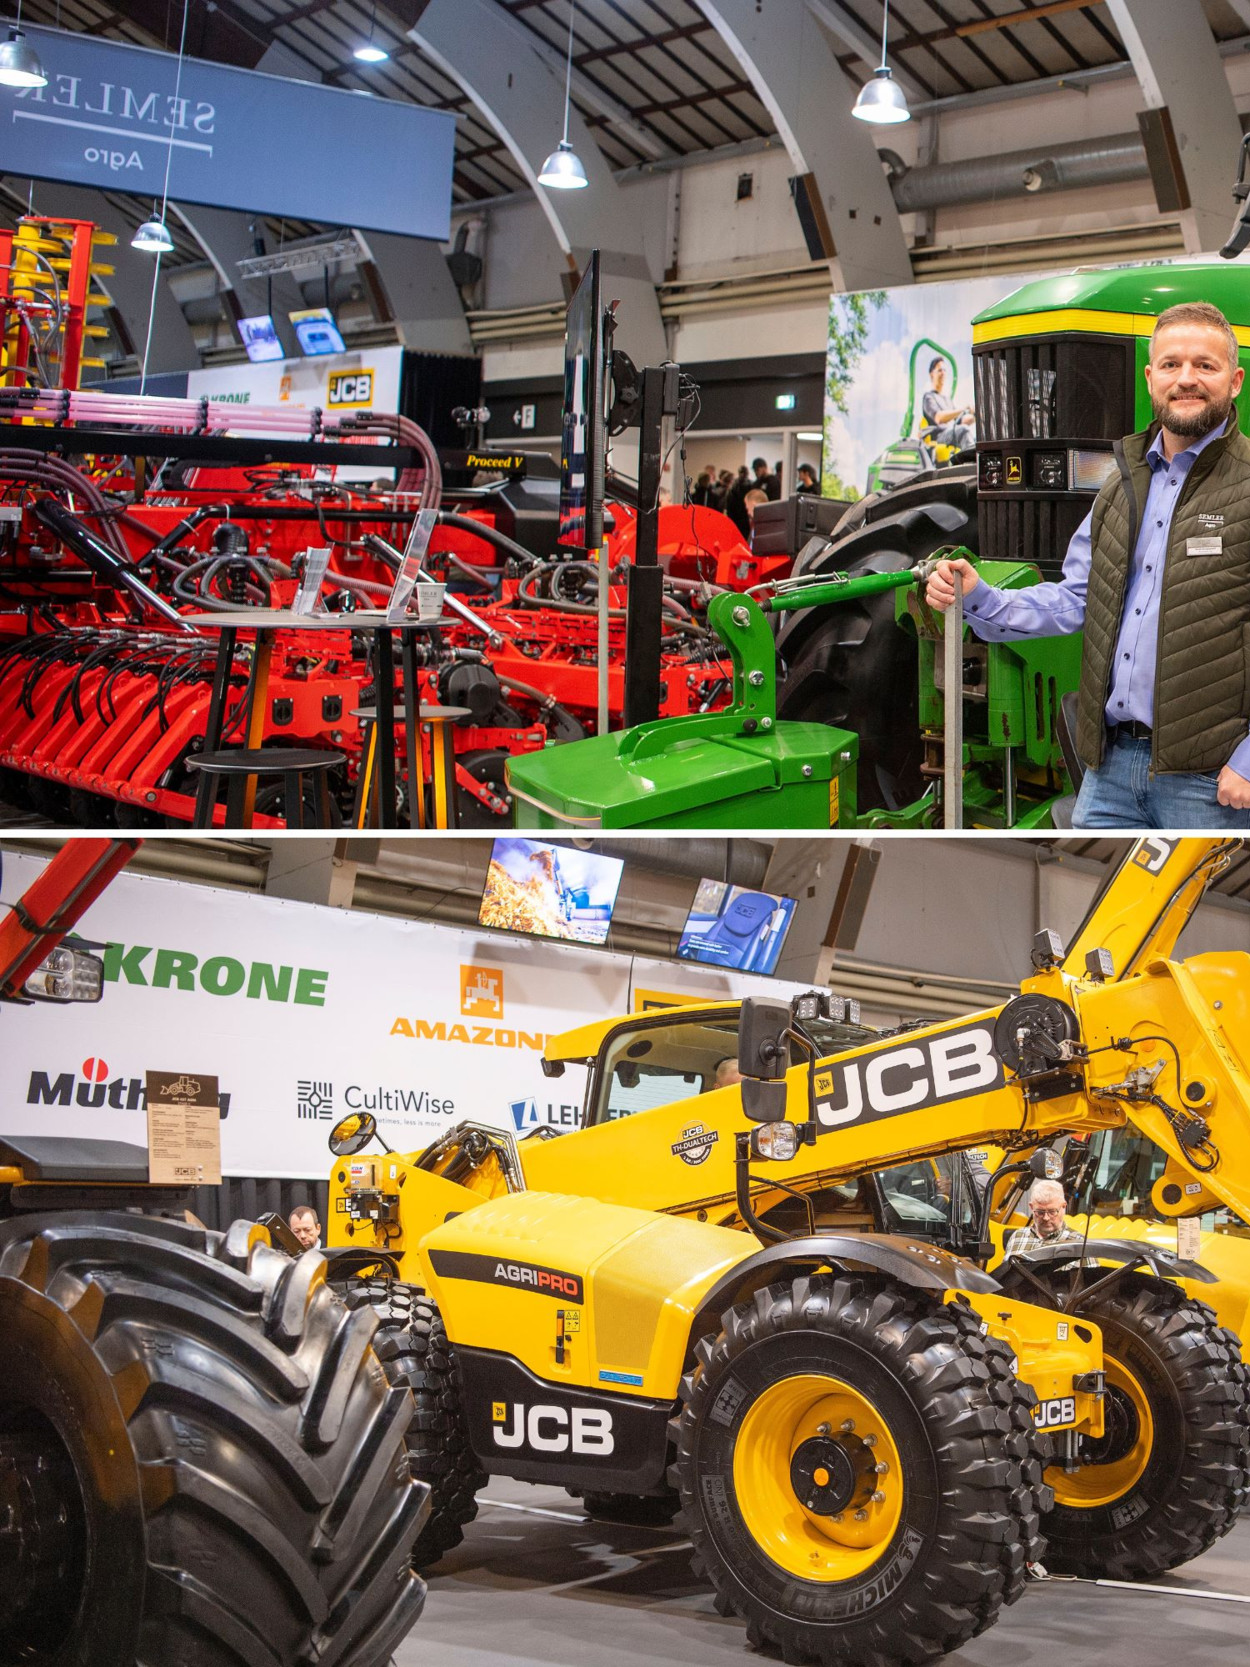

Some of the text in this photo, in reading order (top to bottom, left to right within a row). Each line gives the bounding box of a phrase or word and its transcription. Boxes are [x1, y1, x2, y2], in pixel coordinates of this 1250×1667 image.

[330, 375, 371, 403] JCB
[466, 454, 524, 468] Proceed V
[103, 941, 329, 1007] KRONE
[389, 1017, 556, 1051] AMAZON
[27, 1057, 231, 1120] Müth
[816, 1028, 998, 1126] JCB
[344, 1085, 455, 1115] CultiWise
[672, 1131, 718, 1154] TH-DUALTECH
[683, 1125, 704, 1138] JCB
[494, 1263, 579, 1296] AGRIPRO
[1034, 1398, 1075, 1427] JCB
[493, 1403, 615, 1456] JCB
